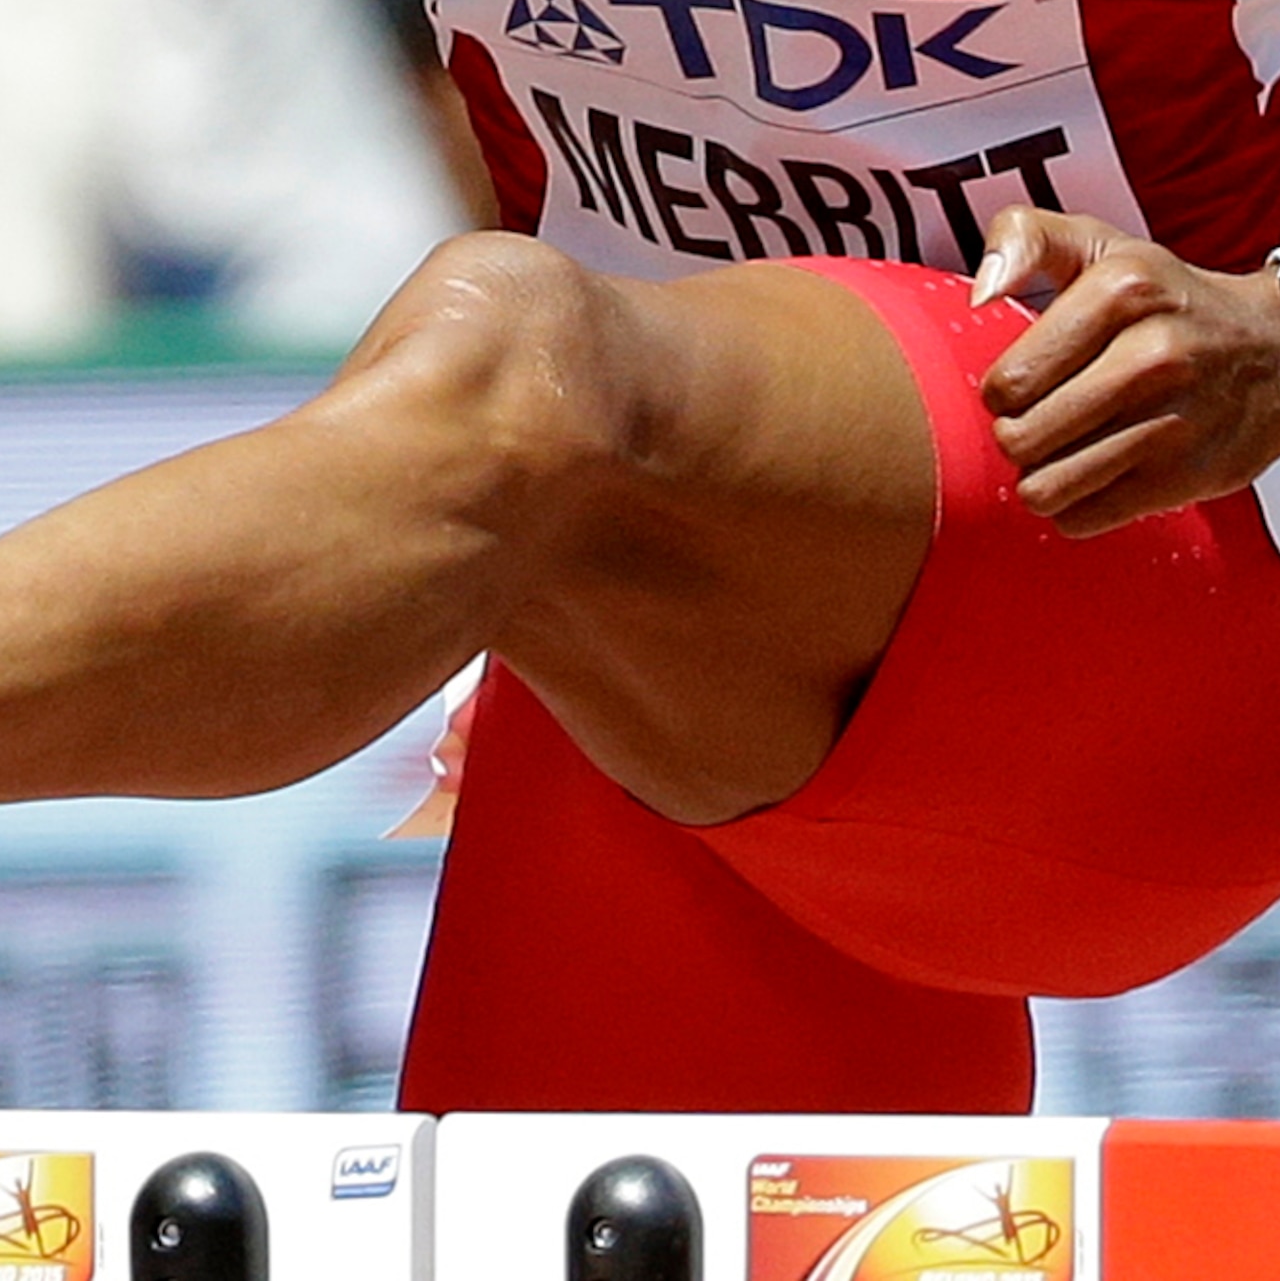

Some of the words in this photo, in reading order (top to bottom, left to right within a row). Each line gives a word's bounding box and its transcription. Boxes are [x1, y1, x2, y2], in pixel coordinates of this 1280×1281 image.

[530, 86, 1072, 275] MERRITT
[339, 1155, 394, 1177] IAAF
[751, 1178, 799, 1196] World
[751, 1195, 867, 1217] Championships
